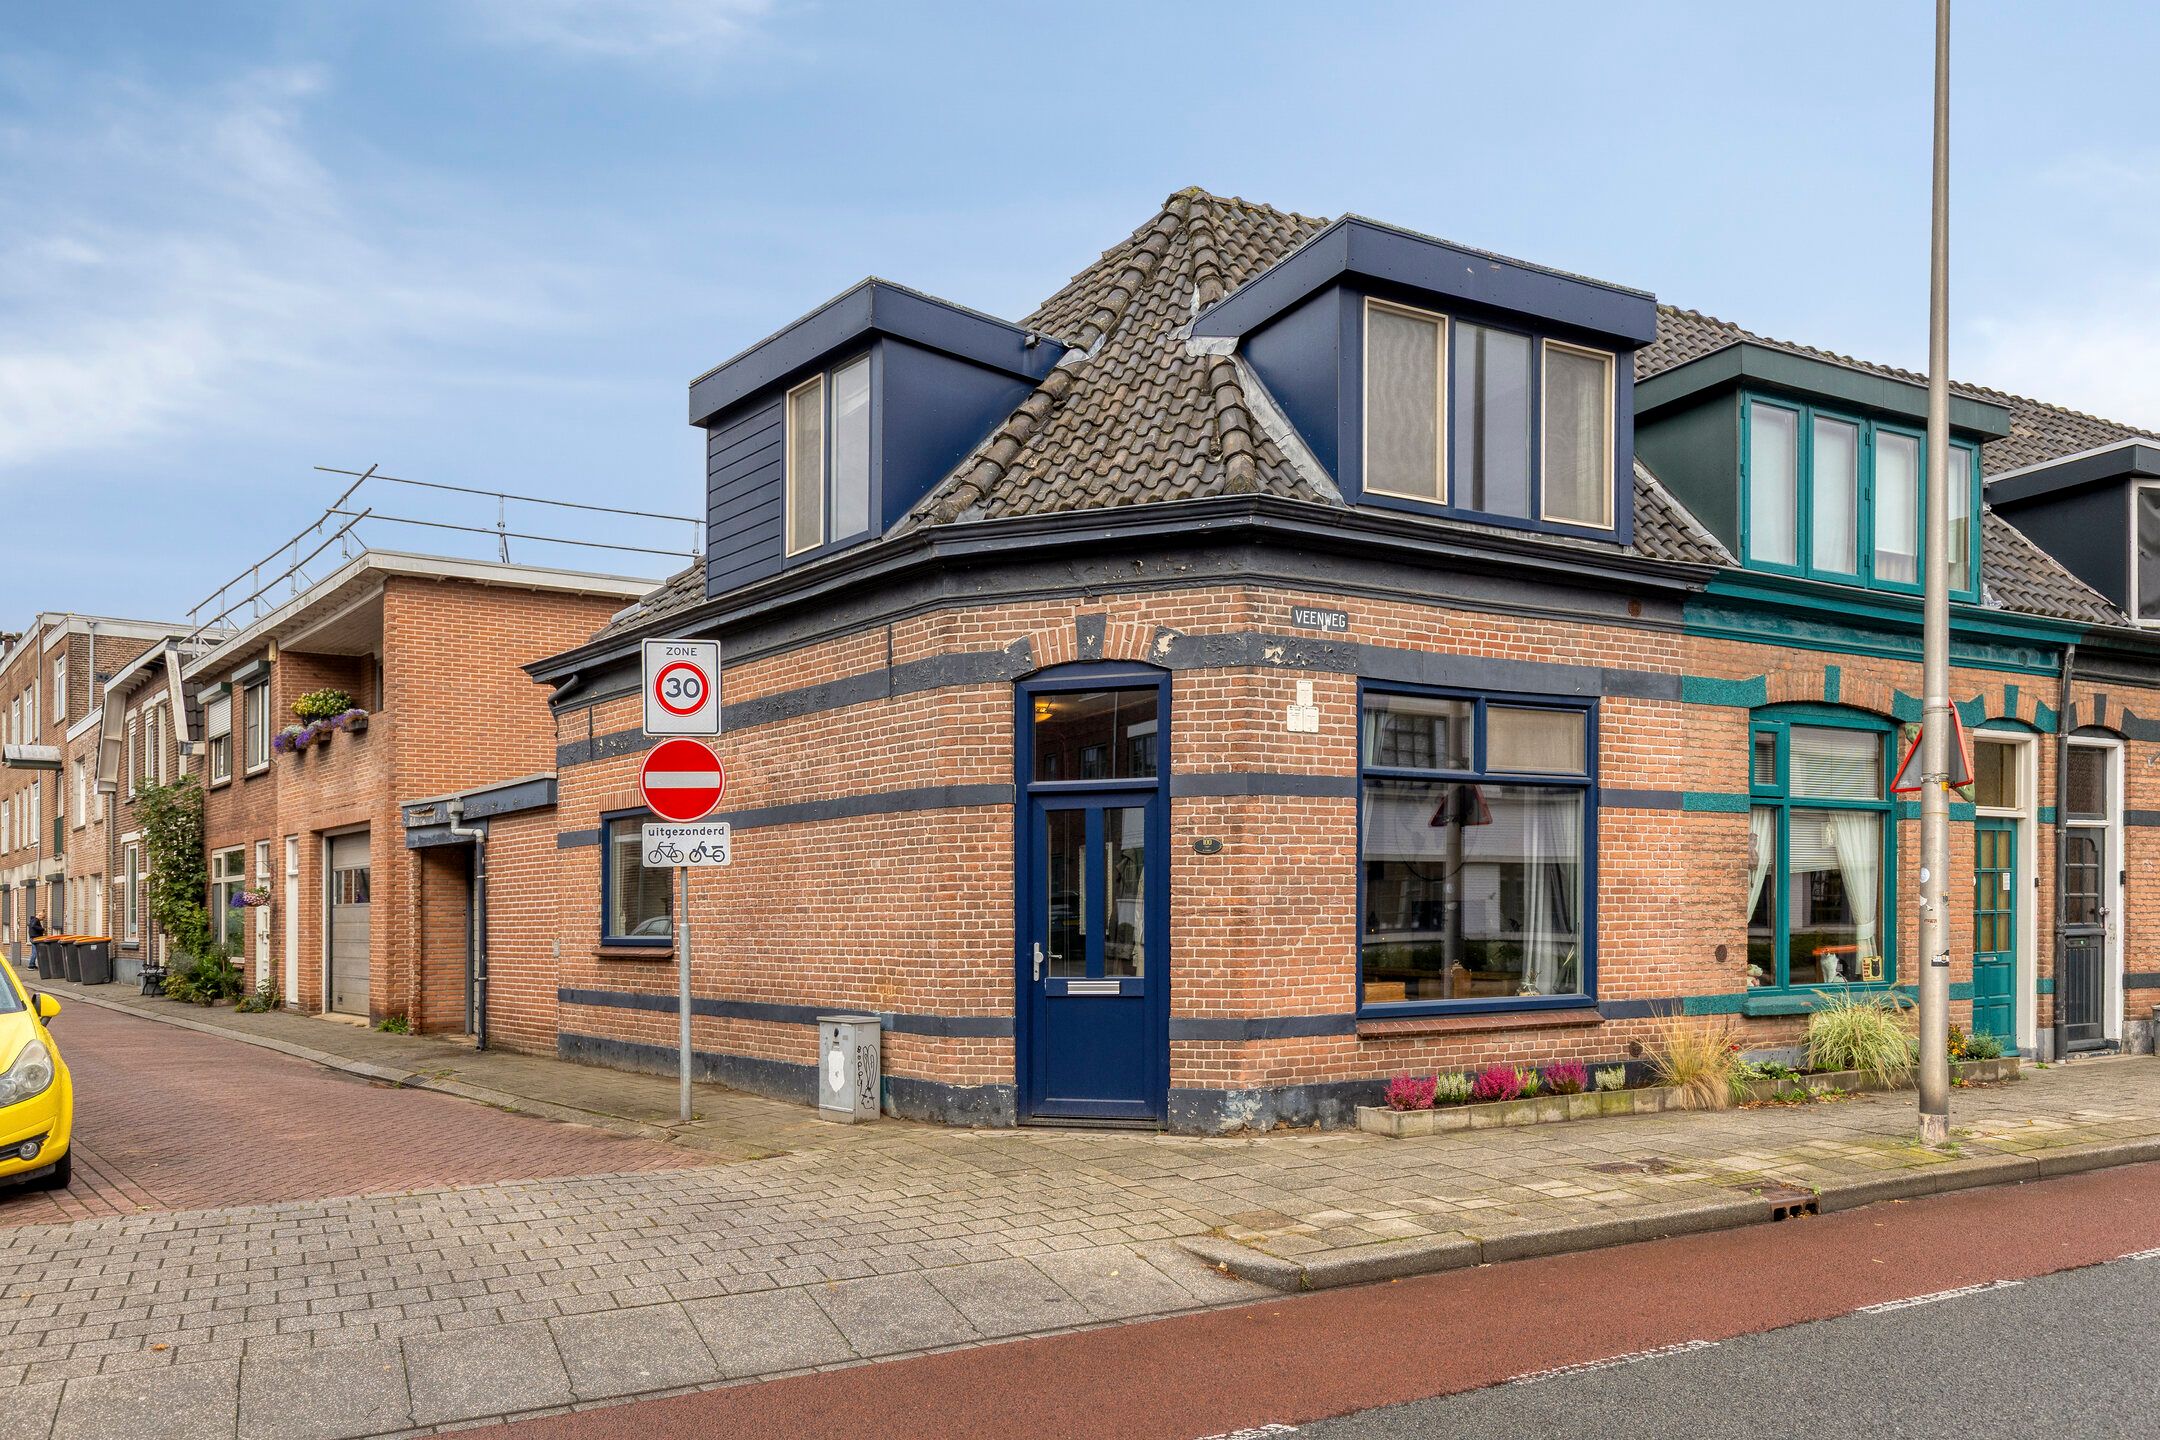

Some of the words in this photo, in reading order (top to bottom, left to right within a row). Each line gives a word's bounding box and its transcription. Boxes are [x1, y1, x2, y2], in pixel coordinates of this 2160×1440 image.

[1295, 609, 1346, 628] VEENWEG
[665, 646, 698, 656] ZONE
[665, 677, 700, 699] 30
[648, 826, 725, 839] uitgezonderd
